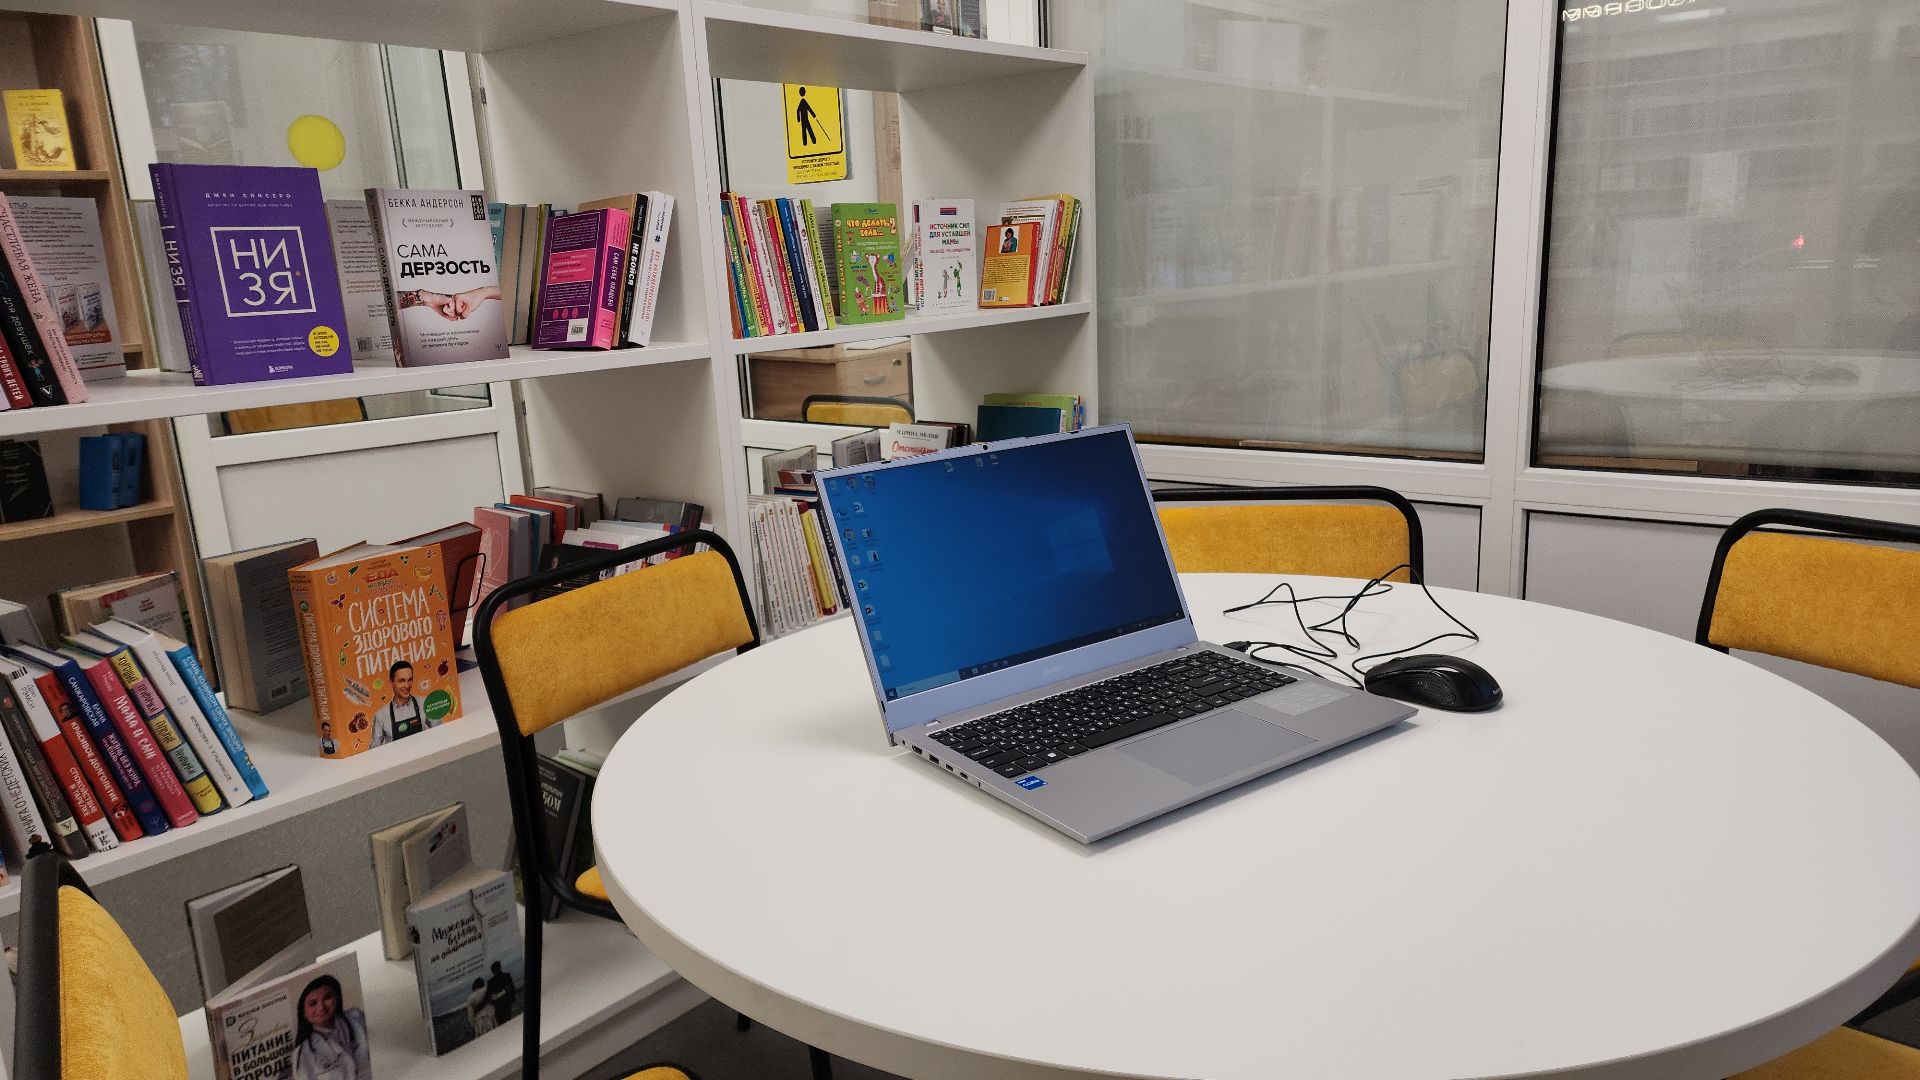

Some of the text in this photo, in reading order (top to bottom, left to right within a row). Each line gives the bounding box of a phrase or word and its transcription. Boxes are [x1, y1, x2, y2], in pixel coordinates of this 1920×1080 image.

[388, 199, 464, 209] БЕККА АНДЕРСОН
[846, 219, 860, 228] ЧТО
[929, 229, 971, 239] ДЛЯ УСТАВШЕЙ
[230, 238, 291, 269] НИ
[397, 244, 449, 259] САМА
[627, 242, 641, 286] НЕ БОЙСЯ
[400, 260, 491, 279] ДЕРЗОСТЬ
[611, 266, 619, 281] СЕБЕ
[23, 273, 42, 303] ЖЕНА
[378, 247, 396, 327] САМА ДЕРЗОСТЬ
[607, 281, 616, 307] ПЛАЦЕБО
[11, 316, 34, 355] девушек
[0, 356, 25, 400] ТРОИХ ДЕТЕЙ
[348, 586, 431, 634] СИСТЕМА
[352, 616, 433, 655] ЗДОРОВОГО
[356, 636, 436, 679] ПИТАНИЯ
[68, 677, 99, 728] САНЖАРОВСКАЯ
[92, 703, 107, 724] ЕЛЕНА
[316, 685, 331, 721] ПИТАНИЯ
[70, 721, 119, 802] КРАСИВОЕ ДОЛГОЛЕТИЕ
[119, 754, 132, 769] БЕЗ
[126, 766, 141, 787] ЖИРА
[69, 767, 98, 815] СПОКОЙСТВИЕ
[74, 787, 91, 817] ТАРЕЛКЕ
[19, 808, 37, 835] КНИГА
[231, 1030, 291, 1066] ПИТАНИЕ
[233, 1043, 294, 1075] В БОЛЬШОМ
[237, 1055, 291, 1080] ОРОДЕ
